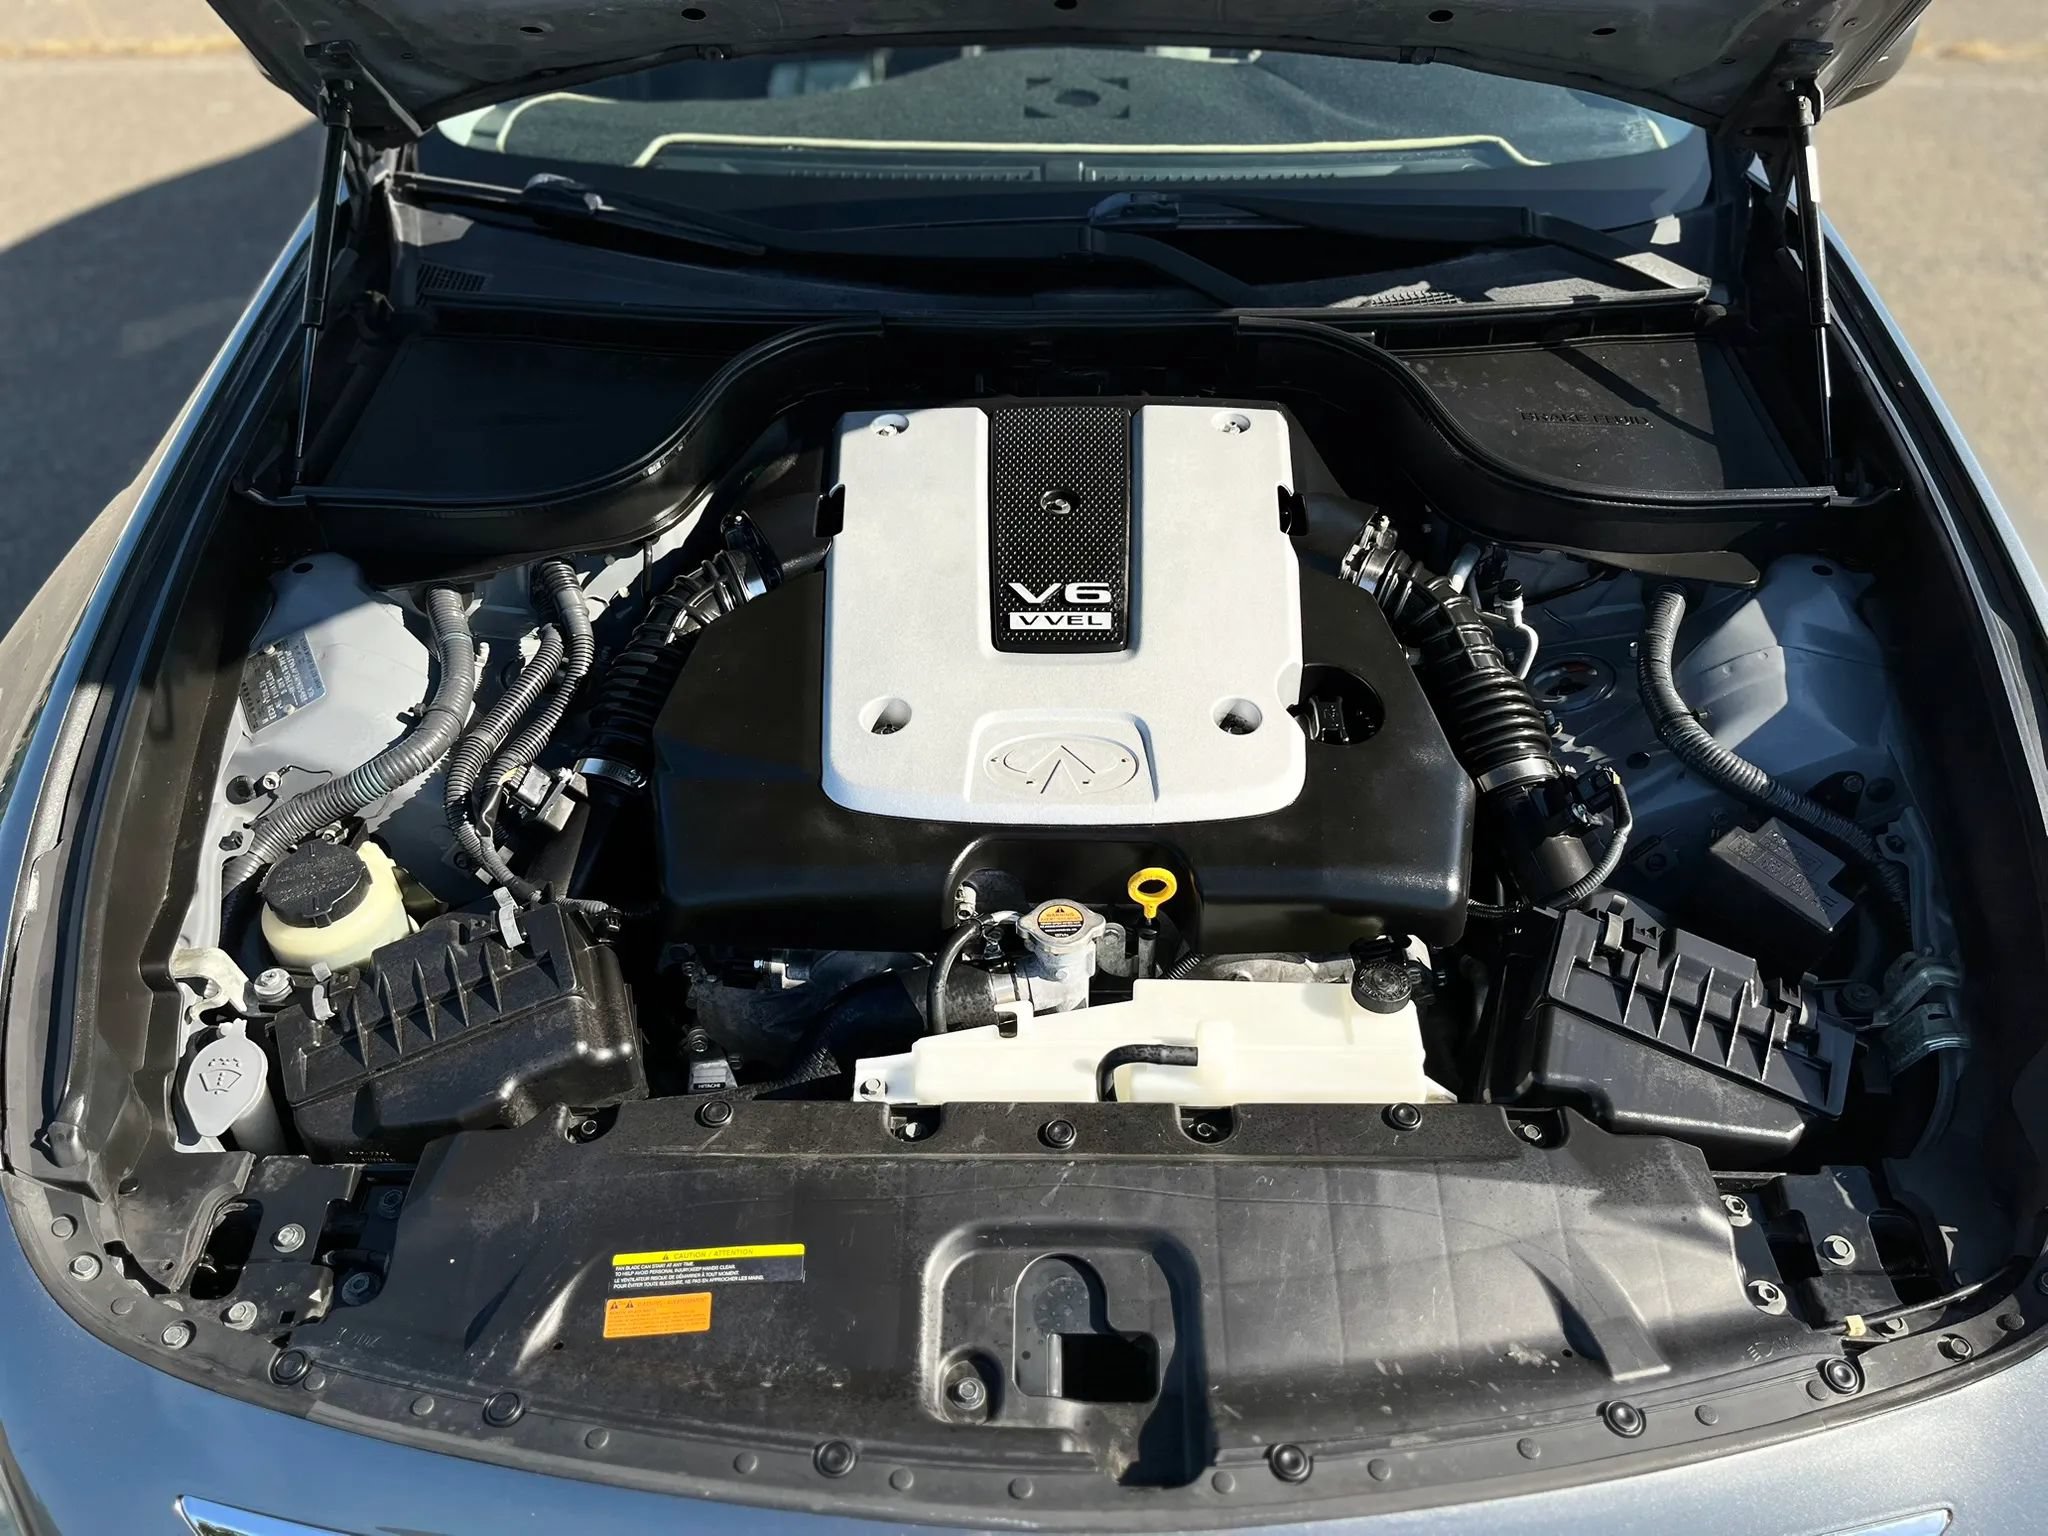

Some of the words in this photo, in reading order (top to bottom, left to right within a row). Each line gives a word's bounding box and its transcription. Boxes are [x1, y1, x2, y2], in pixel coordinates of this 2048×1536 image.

[1520, 412, 1587, 422] BRAKE
[1592, 414, 1650, 426] FLUID
[1008, 582, 1112, 604] V6
[1019, 615, 1103, 626] VVEL
[674, 1250, 706, 1260] CAUTION
[714, 1248, 753, 1256] ATTENTION
